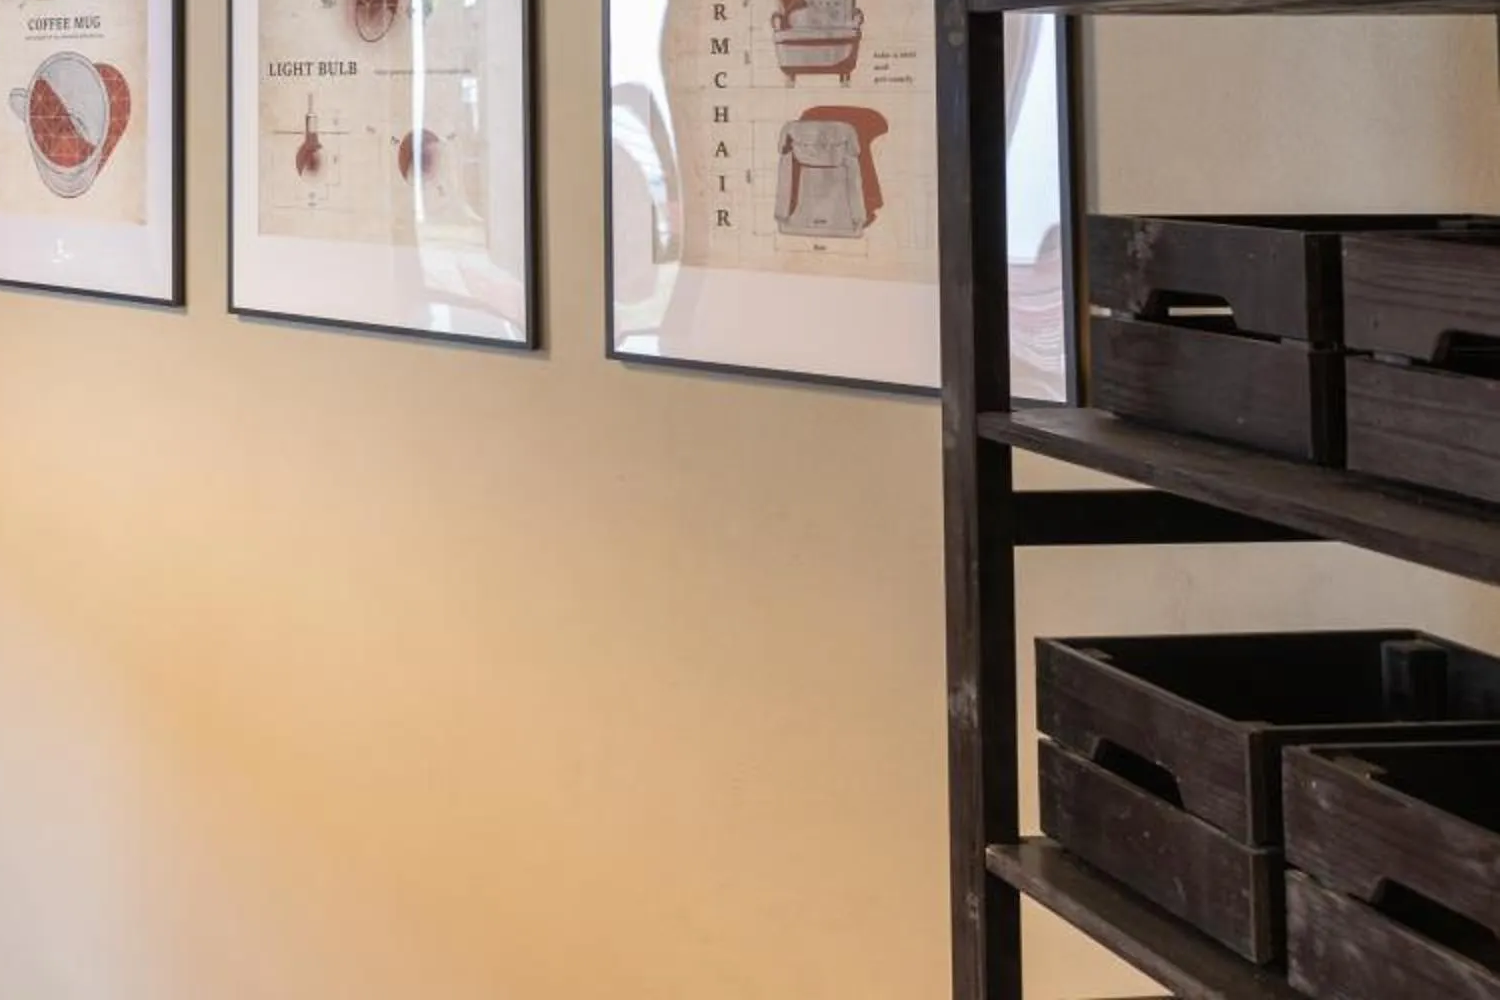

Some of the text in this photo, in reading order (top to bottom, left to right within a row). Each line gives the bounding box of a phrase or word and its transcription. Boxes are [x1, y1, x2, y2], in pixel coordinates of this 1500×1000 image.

[27, 14, 101, 31] COFFEE MUG
[268, 61, 314, 77] LIGHT
[318, 60, 358, 76] BULB
